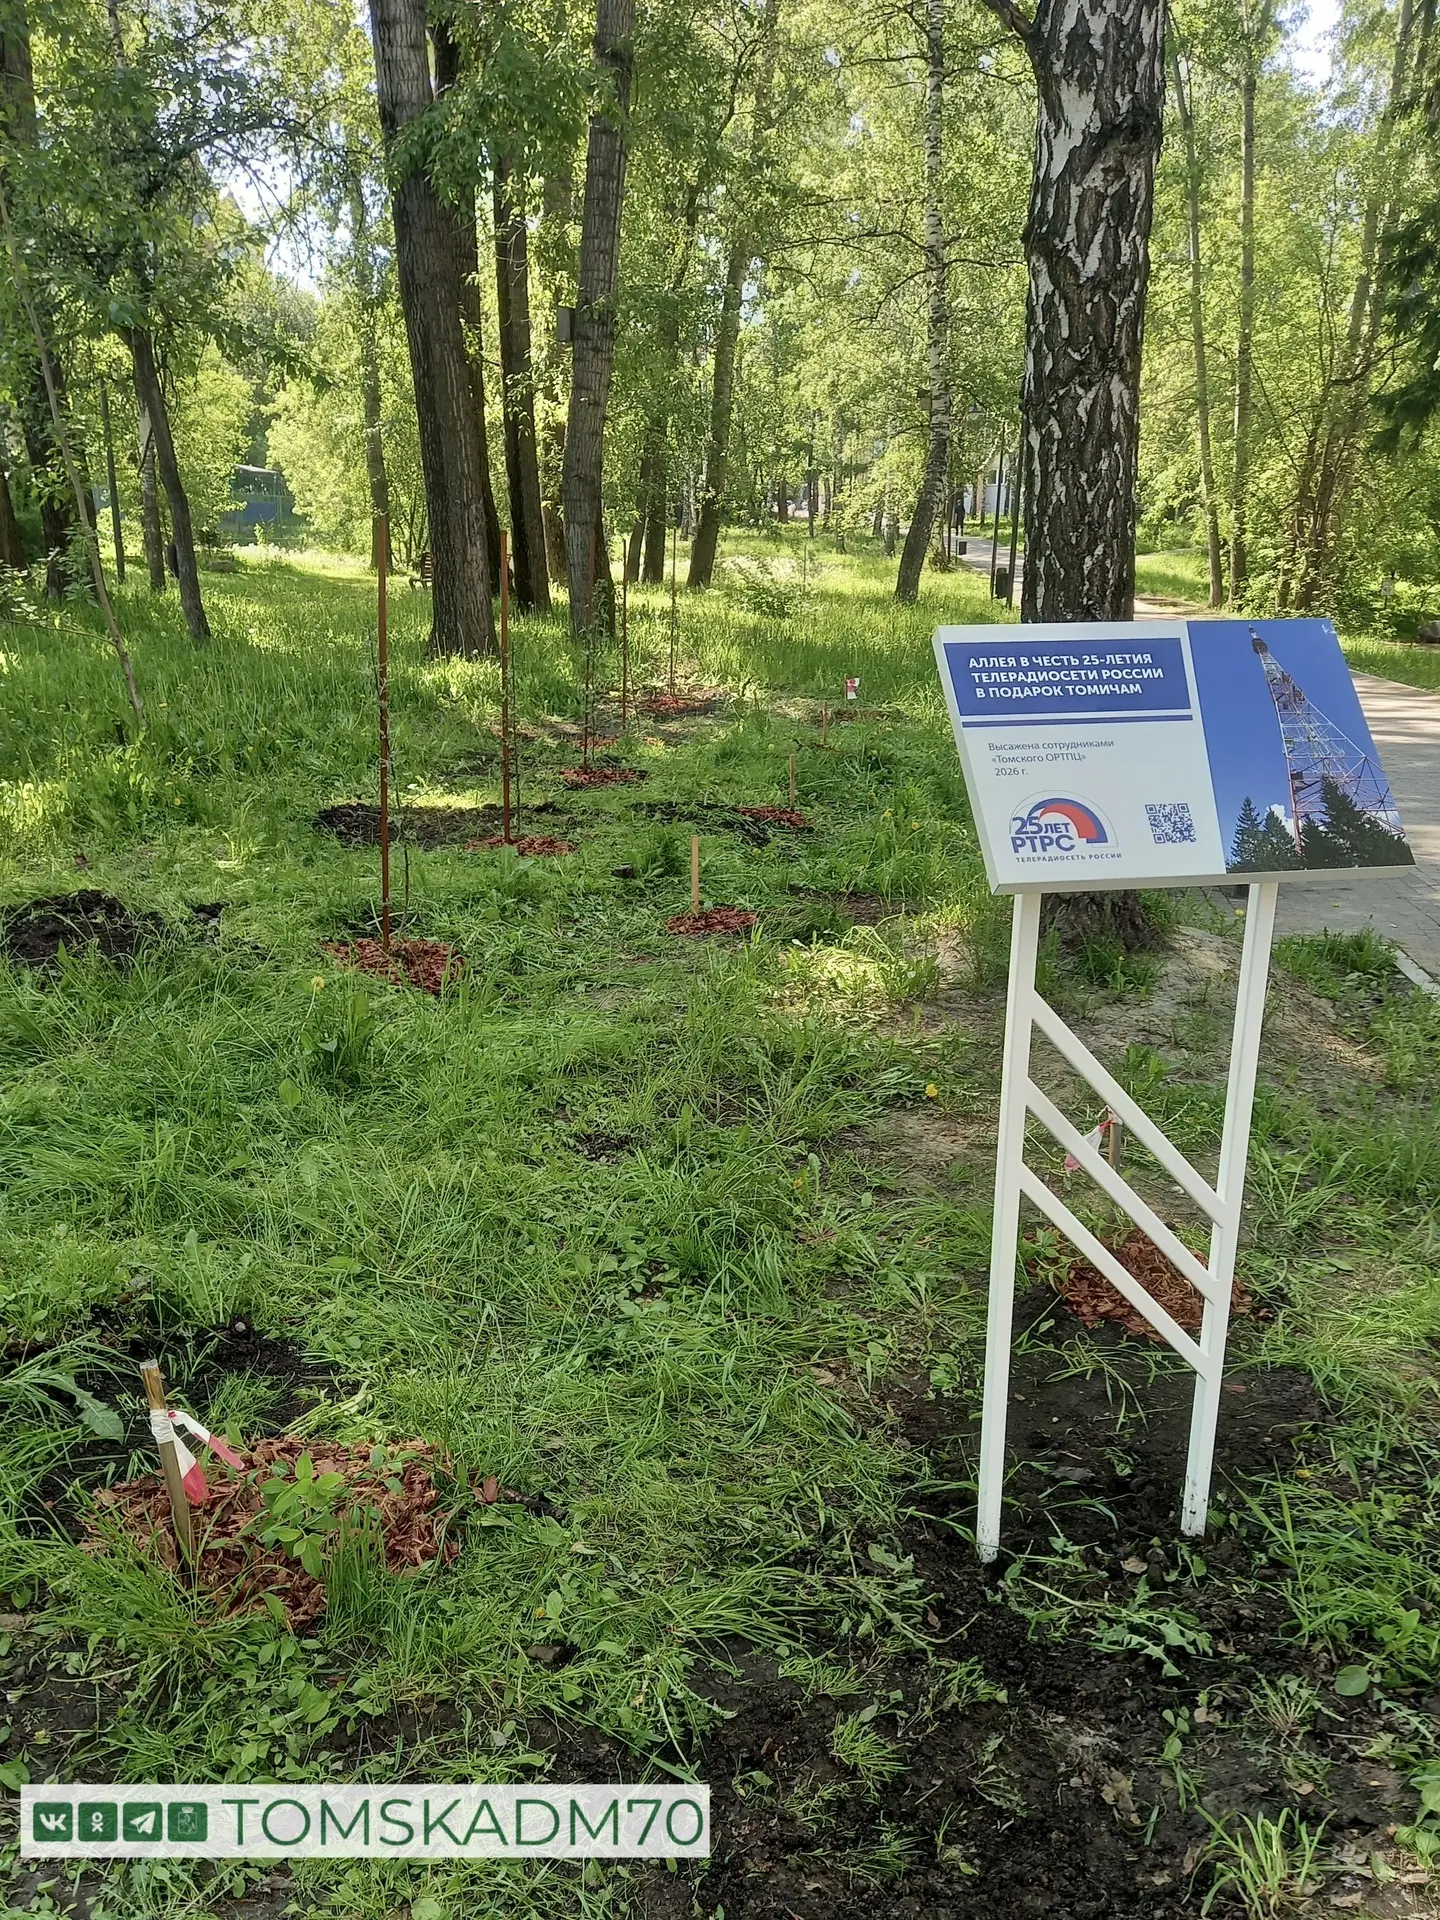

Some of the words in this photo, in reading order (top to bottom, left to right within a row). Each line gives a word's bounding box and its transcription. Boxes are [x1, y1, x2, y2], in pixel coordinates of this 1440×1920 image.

[969, 657, 1016, 668] АЛЛЕЯ
[1020, 656, 1029, 667] В
[1032, 655, 1079, 667] ЧЕСТЬ
[1082, 654, 1152, 666] 25-ЛЕТИЯ
[971, 670, 1098, 684] ТЕЛЕРАДИОСЕТИ
[1102, 668, 1163, 680] РОССИИ
[976, 687, 985, 698] В
[989, 685, 1064, 698] ПОДАРОК
[1066, 683, 1142, 696] ТОМИЧАМ
[988, 742, 1040, 752] Высажена
[1042, 740, 1115, 750] сотрудниками
[992, 755, 1044, 764] «Томского
[1046, 752, 1086, 763] ОРТПЦ»
[995, 768, 1019, 776] 2026
[1021, 768, 1028, 776] г.
[1012, 816, 1043, 834] 25
[1044, 823, 1070, 833] ЛЕТ
[1011, 835, 1075, 853] РТРС
[1016, 855, 1086, 863] ТЕЛЕРАДИОСЕТЬ
